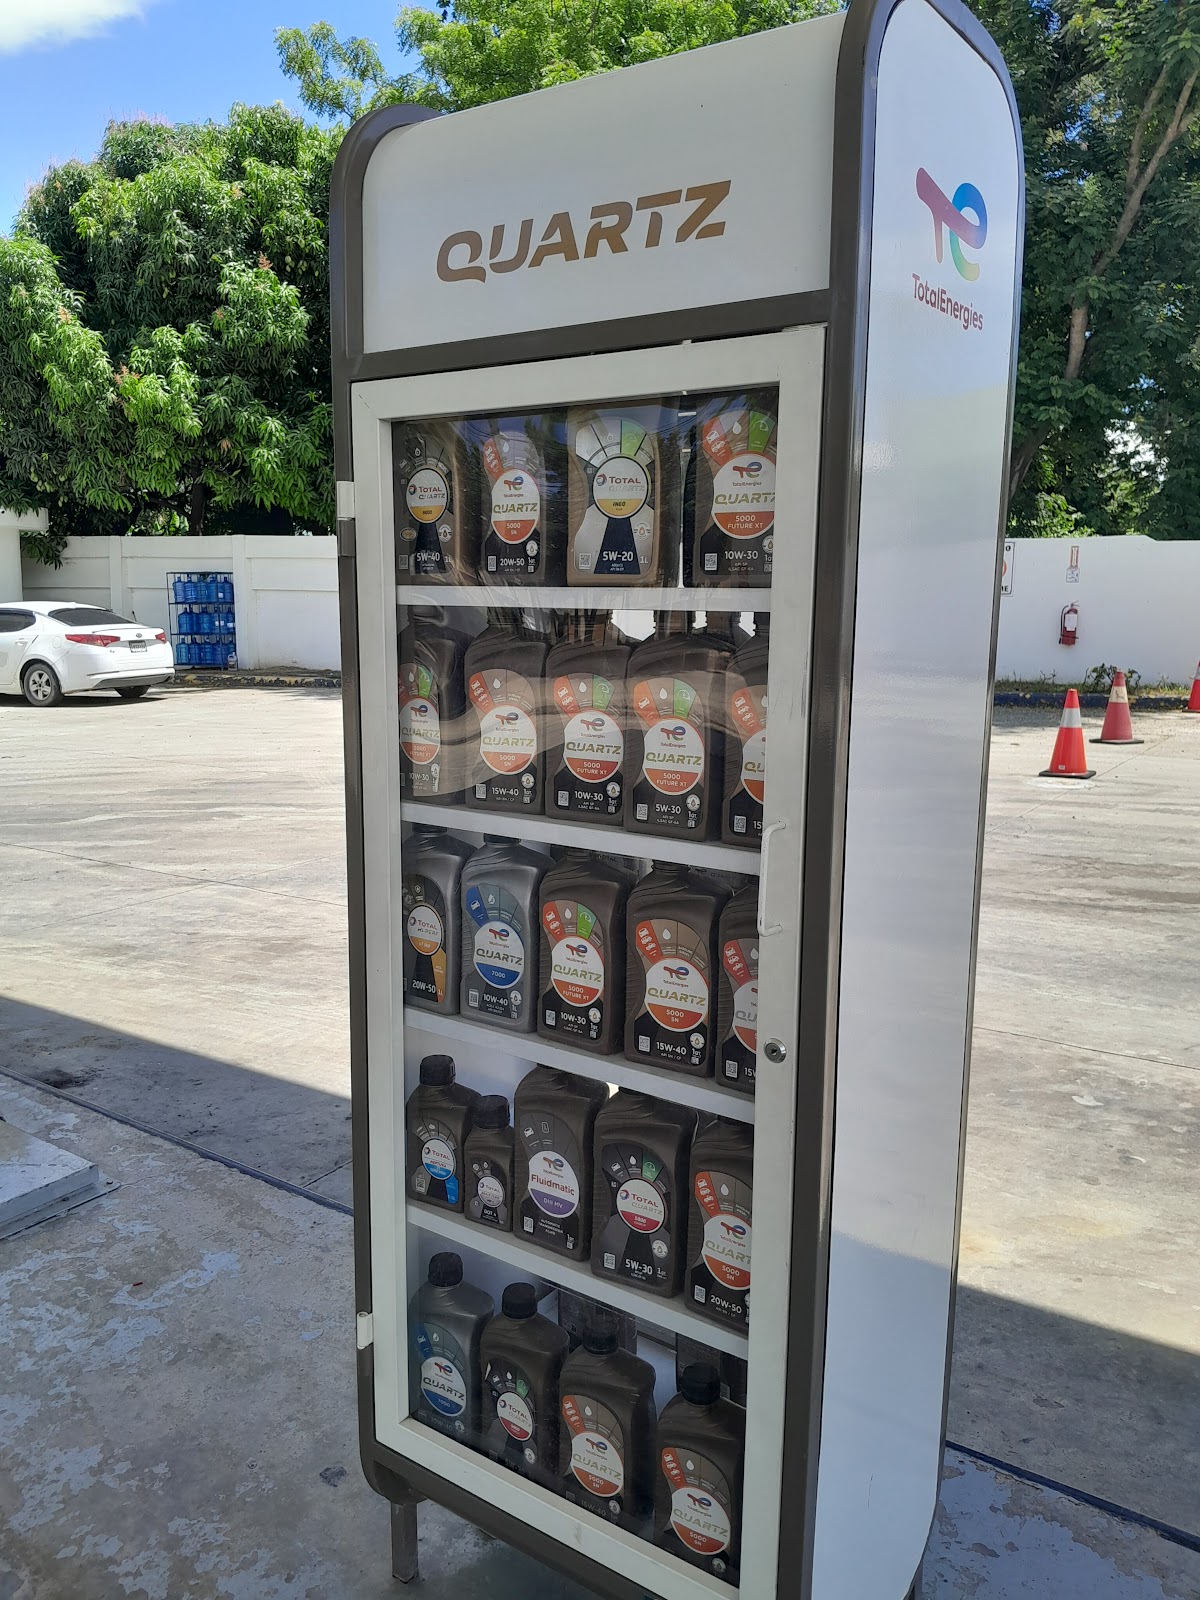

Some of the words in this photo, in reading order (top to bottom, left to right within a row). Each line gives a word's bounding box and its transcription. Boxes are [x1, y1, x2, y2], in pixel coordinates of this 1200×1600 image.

[435, 179, 732, 283] QUARTZ
[911, 272, 984, 332] TotalEnergies
[609, 476, 641, 484] TOTAL
[493, 503, 538, 514] QUARTZ
[416, 552, 440, 562] 5W-40
[602, 551, 634, 561] 5W-20
[640, 556, 648, 564] 1L
[724, 550, 759, 560] 10W-30
[500, 558, 525, 566] 20W-50
[401, 726, 440, 739] QUARTZ
[482, 736, 535, 747] QUARTZ
[566, 741, 621, 755] QUARTZ
[646, 752, 702, 766] QUARTZ
[409, 773, 430, 781] 10W-30
[657, 779, 678, 787] FUTURE
[491, 787, 519, 796] 15W-40
[574, 791, 603, 801] 10W-30
[655, 803, 681, 815] 5W-30
[418, 919, 438, 931] TOTAL
[476, 948, 522, 966] QUARTZ
[491, 970, 506, 979] 7000
[553, 963, 602, 983] QUARTZ
[412, 980, 436, 994] 20W-50
[568, 985, 584, 993] 5000
[482, 993, 508, 1006] 10W-40
[563, 990, 582, 1000] FUTURE
[647, 987, 706, 1007] QUARTZ
[560, 1011, 586, 1025] 10W-30
[666, 1009, 684, 1018] 5000
[656, 1041, 686, 1055] 15W-40
[432, 1149, 450, 1160] TOTAL
[531, 1174, 575, 1196] Fluidmatic
[631, 1193, 658, 1208] TOTAL
[705, 1240, 751, 1264] QUART
[625, 1258, 653, 1275] 5W-30
[722, 1265, 740, 1276] 5000
[726, 1273, 735, 1281] SN
[710, 1294, 742, 1314] 20W-50
[423, 1376, 465, 1401] QUARTZ
[508, 1404, 529, 1420] TOTAL
[573, 1453, 622, 1480] QUARTZ
[588, 1474, 604, 1485] 5000
[674, 1508, 728, 1537] QUARTZ
[689, 1531, 707, 1543] 5000
